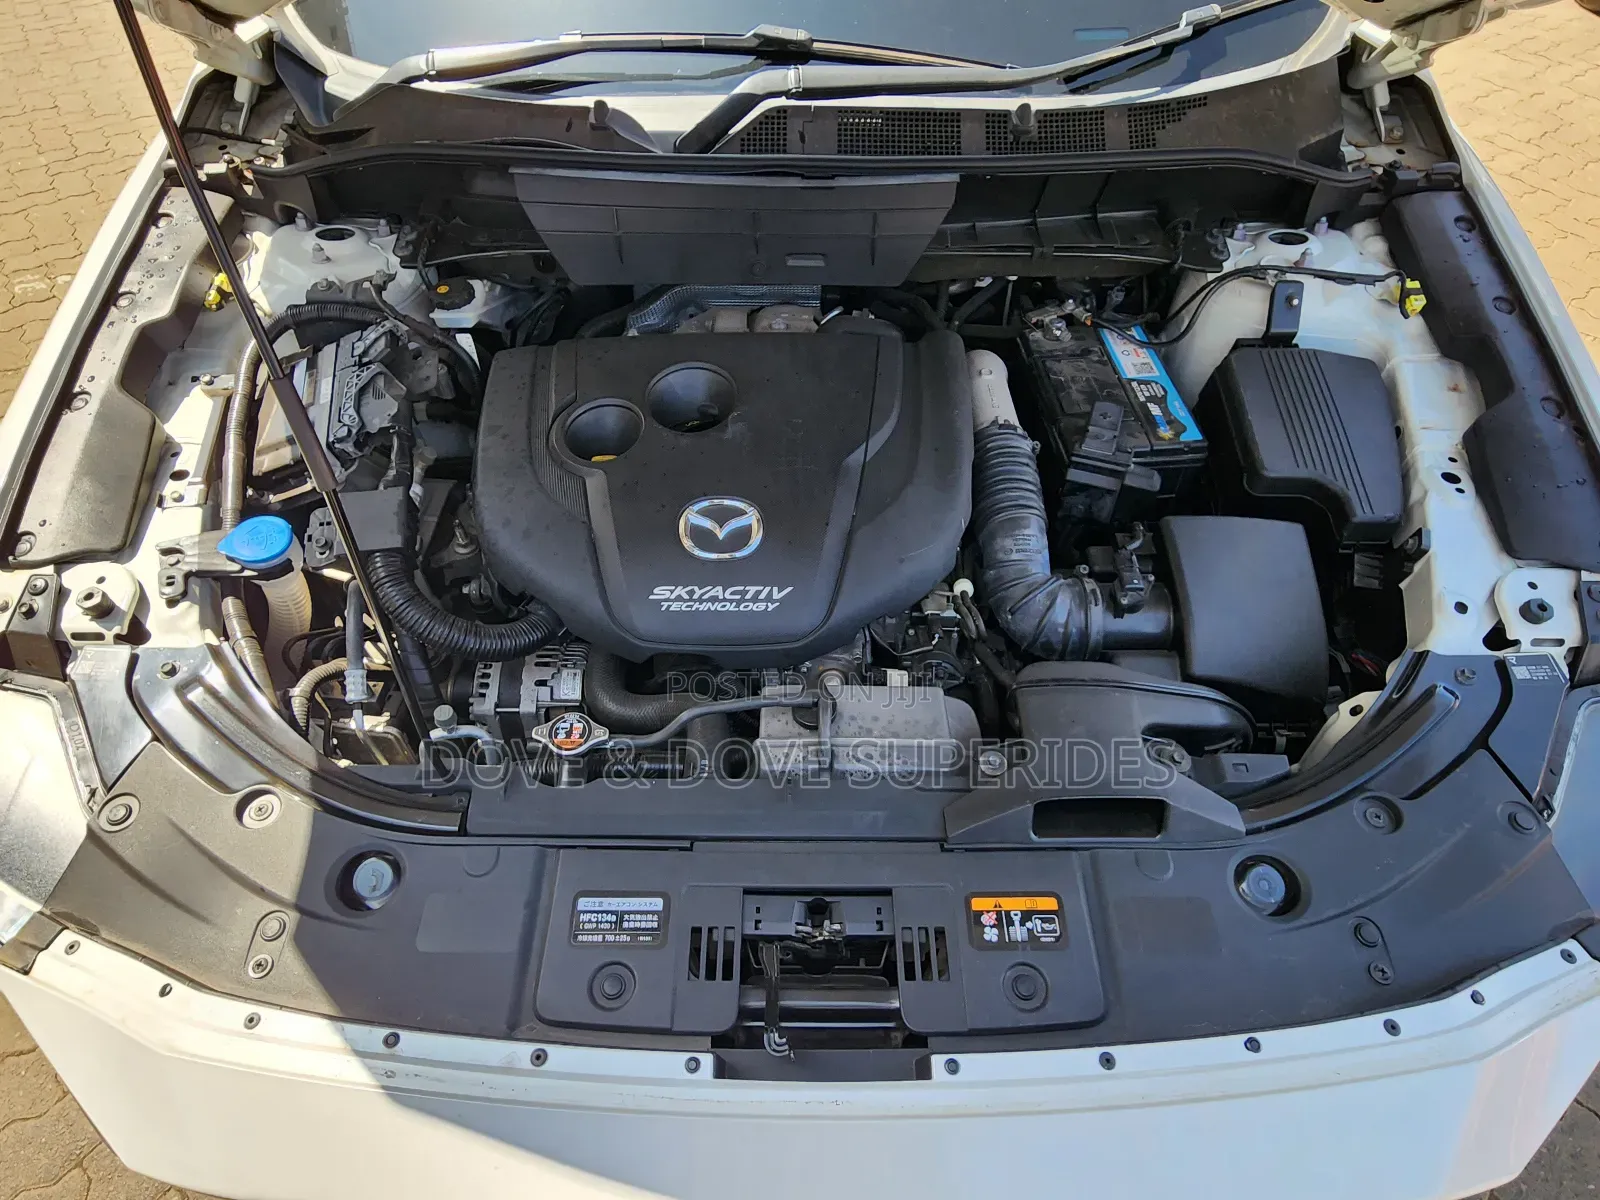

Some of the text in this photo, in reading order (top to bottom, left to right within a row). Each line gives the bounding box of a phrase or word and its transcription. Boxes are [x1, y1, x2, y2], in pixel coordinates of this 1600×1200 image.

[648, 585, 794, 600] SKYACTIV
[660, 601, 780, 612] TECHNOLOGY
[583, 900, 604, 908] ご注意
[580, 913, 617, 922] HFC134a
